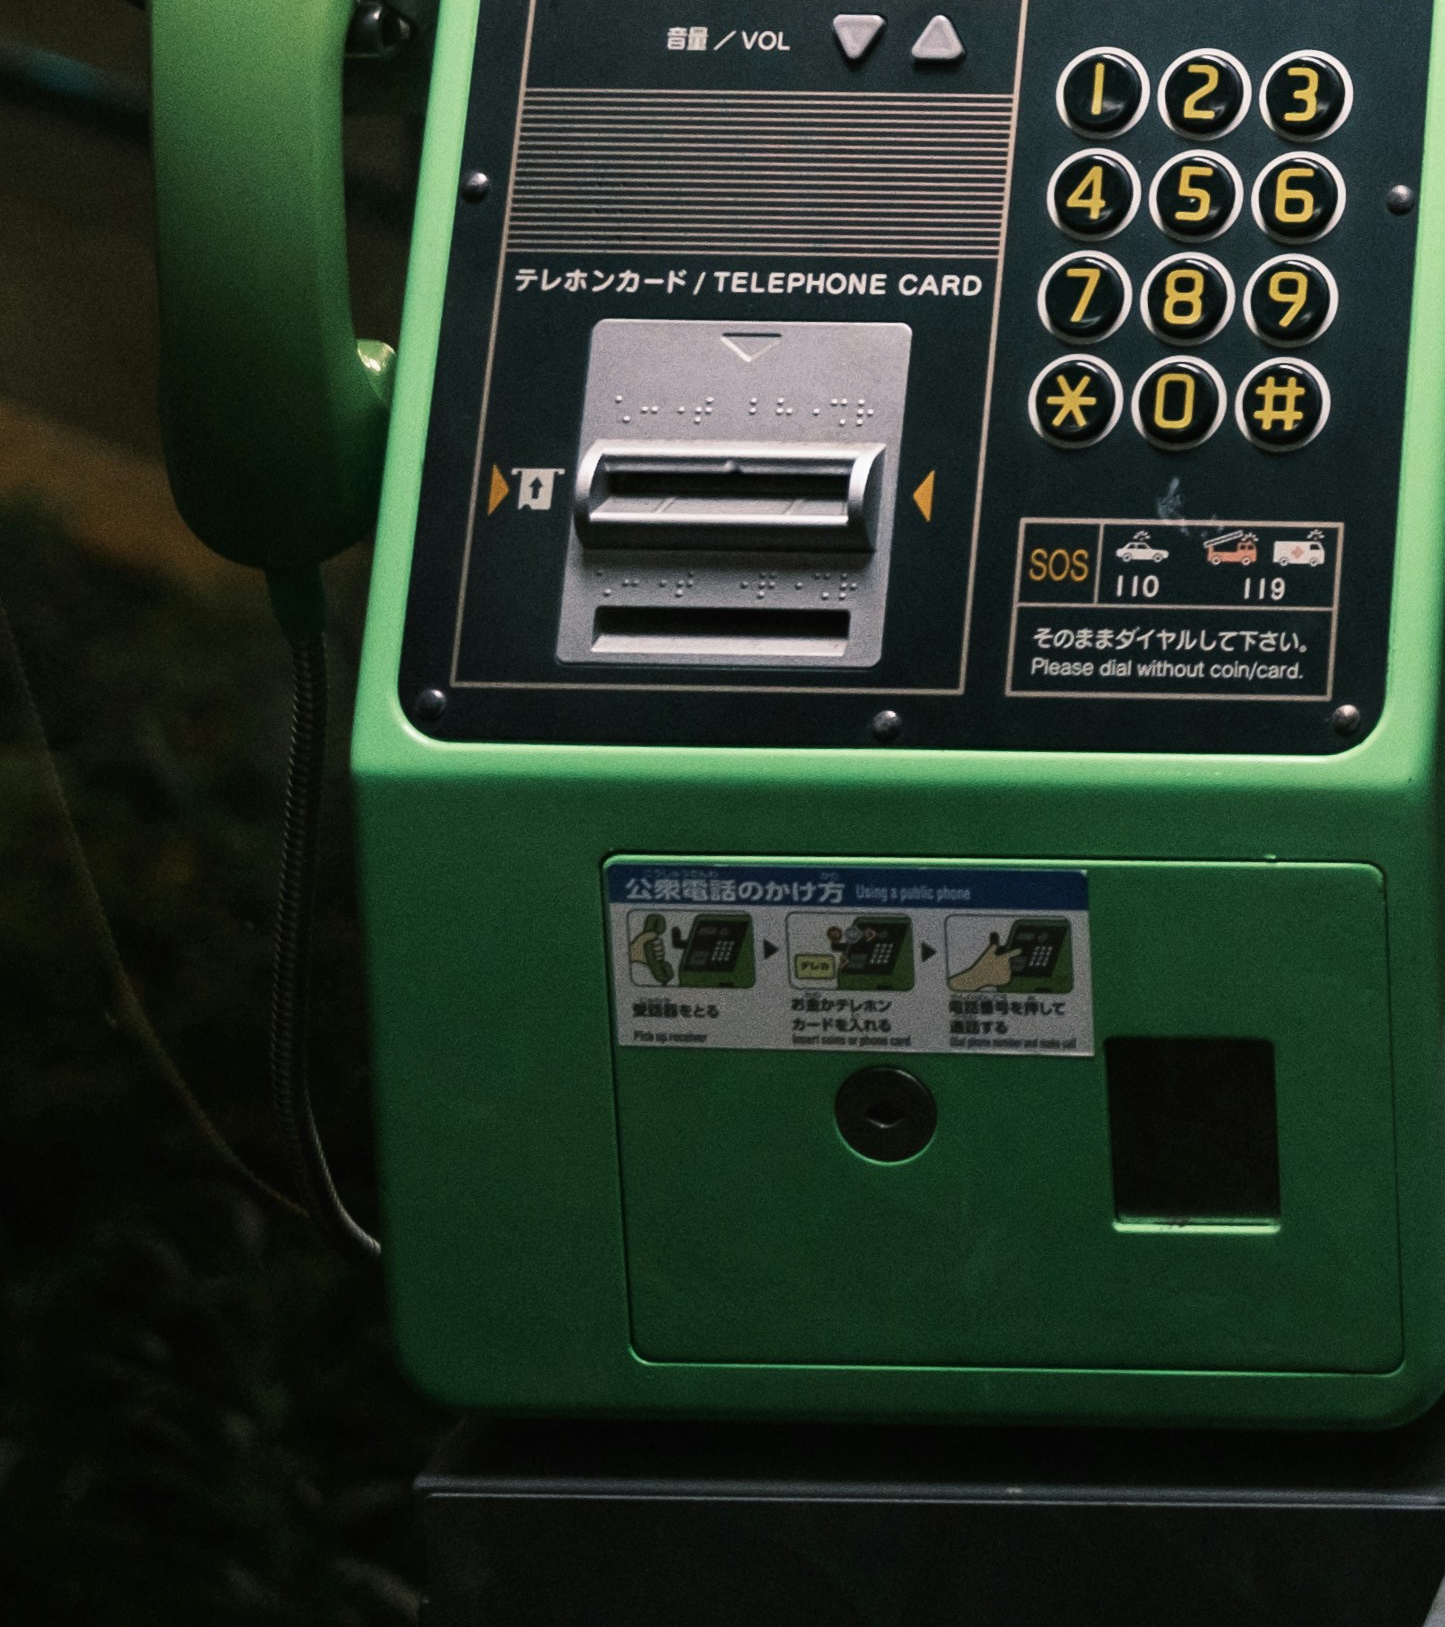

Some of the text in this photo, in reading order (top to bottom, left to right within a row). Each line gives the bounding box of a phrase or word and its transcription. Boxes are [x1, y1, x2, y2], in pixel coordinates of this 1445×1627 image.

[1090, 62, 1319, 122] 1 2 3
[1066, 165, 1315, 223] 4 5 6
[714, 272, 887, 296] TELEPHONE
[899, 274, 984, 296] CARD
[1066, 268, 1308, 327] 7 8 9
[1154, 373, 1195, 430] 0
[1029, 548, 1090, 582] SOS
[1116, 575, 1160, 598] 110
[1244, 577, 1286, 601] 119
[1032, 627, 1308, 654] そのままダイヤルして下さい。
[1031, 657, 1304, 680] Please dial without coin/card.
[625, 877, 845, 904] 公衆電話のかけ方
[855, 884, 971, 903] Using a public phone
